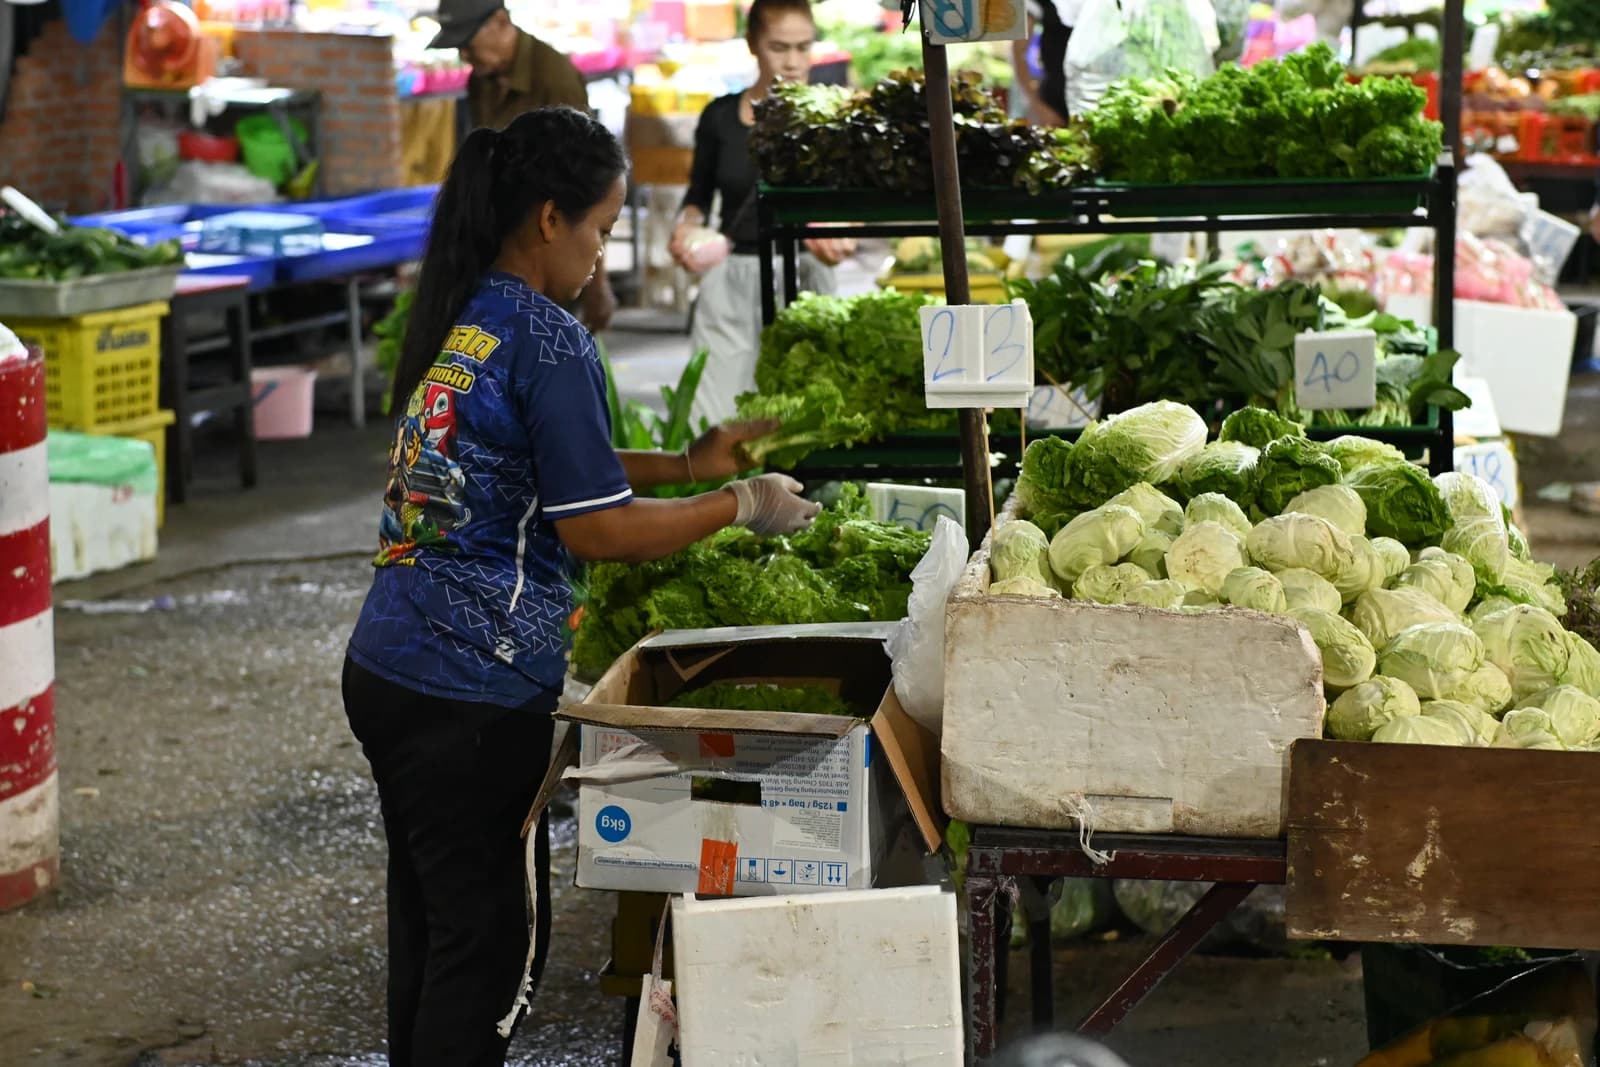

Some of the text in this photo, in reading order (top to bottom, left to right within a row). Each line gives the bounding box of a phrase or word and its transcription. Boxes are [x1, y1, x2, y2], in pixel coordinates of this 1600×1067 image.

[1304, 350, 1360, 393] 40
[769, 799, 781, 808] 48
[789, 798, 805, 810] bag
[813, 800, 833, 810] 125g
[600, 815, 627, 832] 6kg
